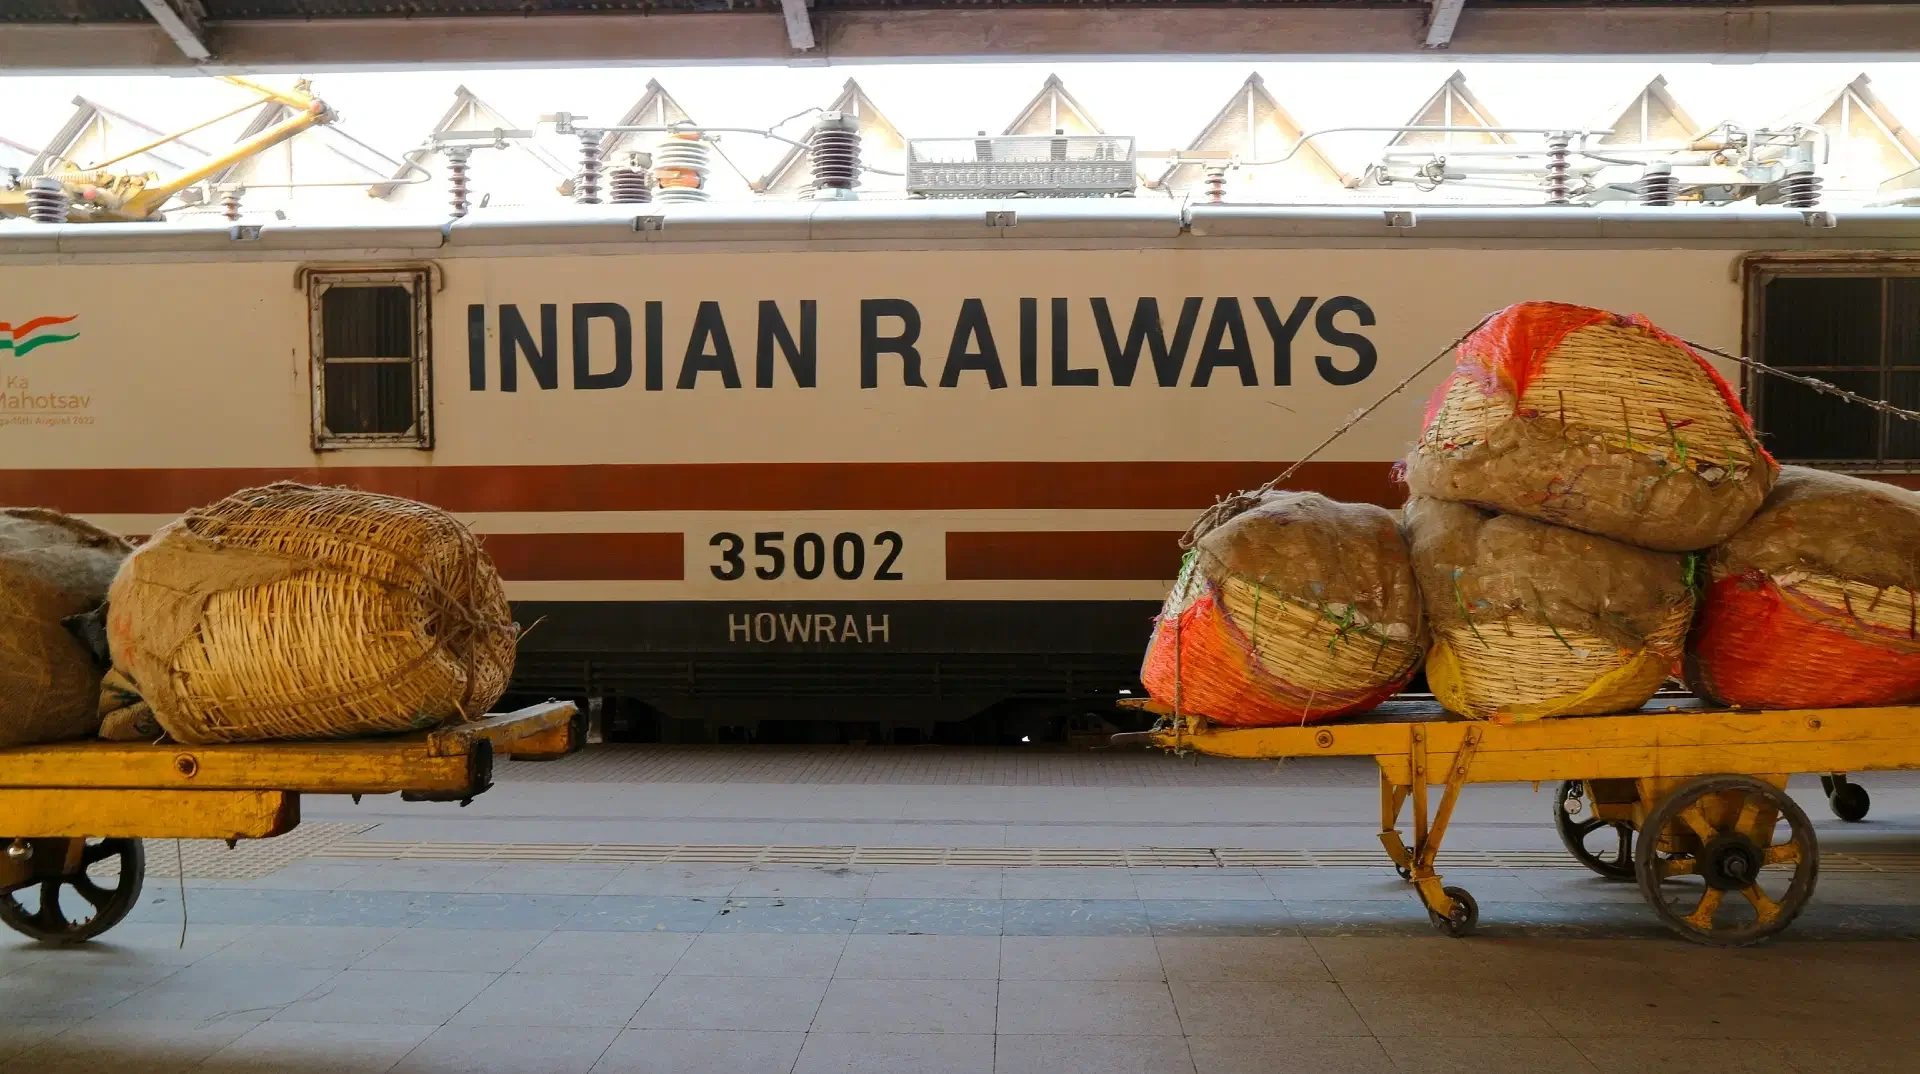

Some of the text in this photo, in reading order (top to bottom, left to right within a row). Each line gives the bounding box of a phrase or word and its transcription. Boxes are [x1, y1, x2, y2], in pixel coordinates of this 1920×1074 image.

[467, 295, 1378, 393] INDIAN RAILWAYS
[7, 375, 29, 389] Ka
[708, 530, 904, 582] 35002
[728, 612, 891, 644] HOWRAH
